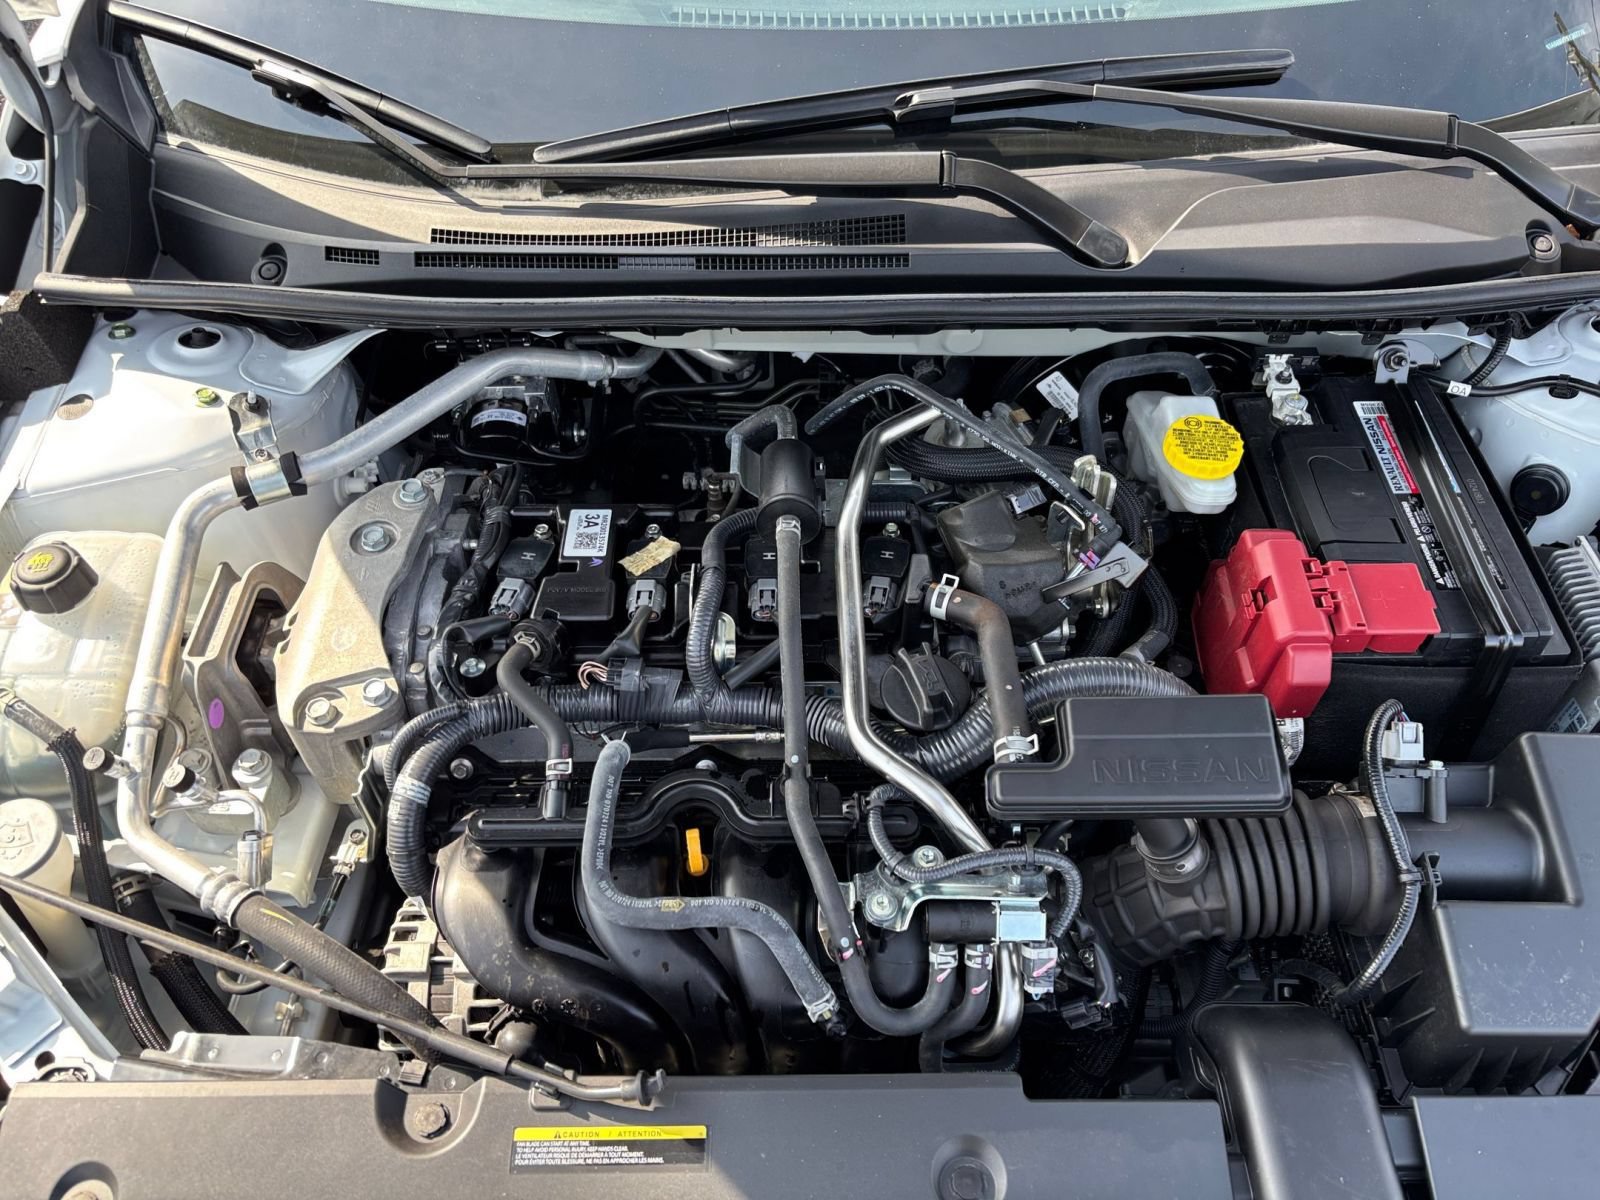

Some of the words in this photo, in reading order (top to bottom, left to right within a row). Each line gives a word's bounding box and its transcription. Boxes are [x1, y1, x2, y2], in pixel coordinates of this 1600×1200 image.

[1363, 417, 1387, 454] NISSAN
[1381, 457, 1404, 491] RENAULT
[583, 513, 600, 529] 3A
[1092, 756, 1270, 784] NISSAN
